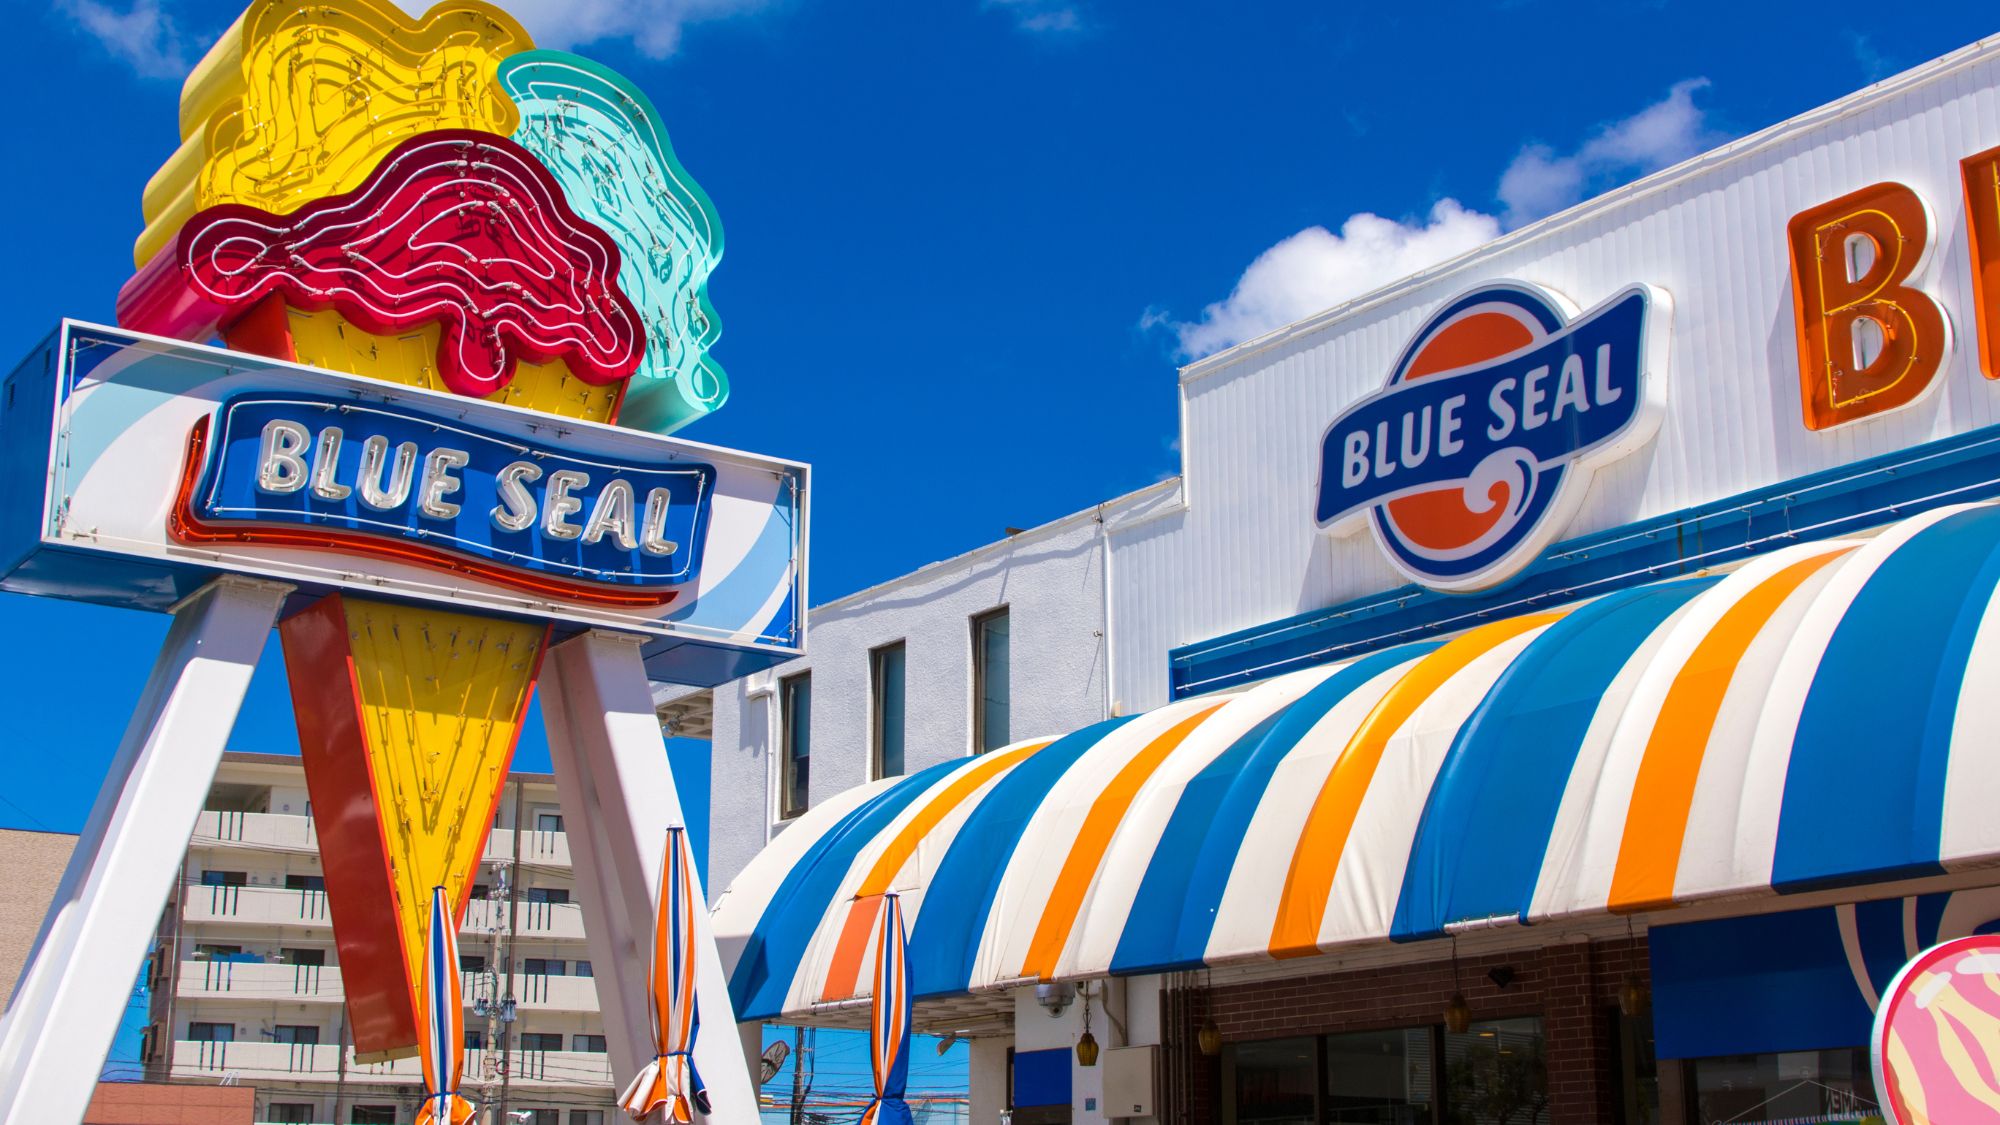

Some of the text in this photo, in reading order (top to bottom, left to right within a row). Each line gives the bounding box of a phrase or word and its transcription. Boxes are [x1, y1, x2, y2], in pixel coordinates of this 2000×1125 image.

[1342, 343, 1622, 489] BLUE SEAL
[258, 419, 679, 557] BLUE SEAL
